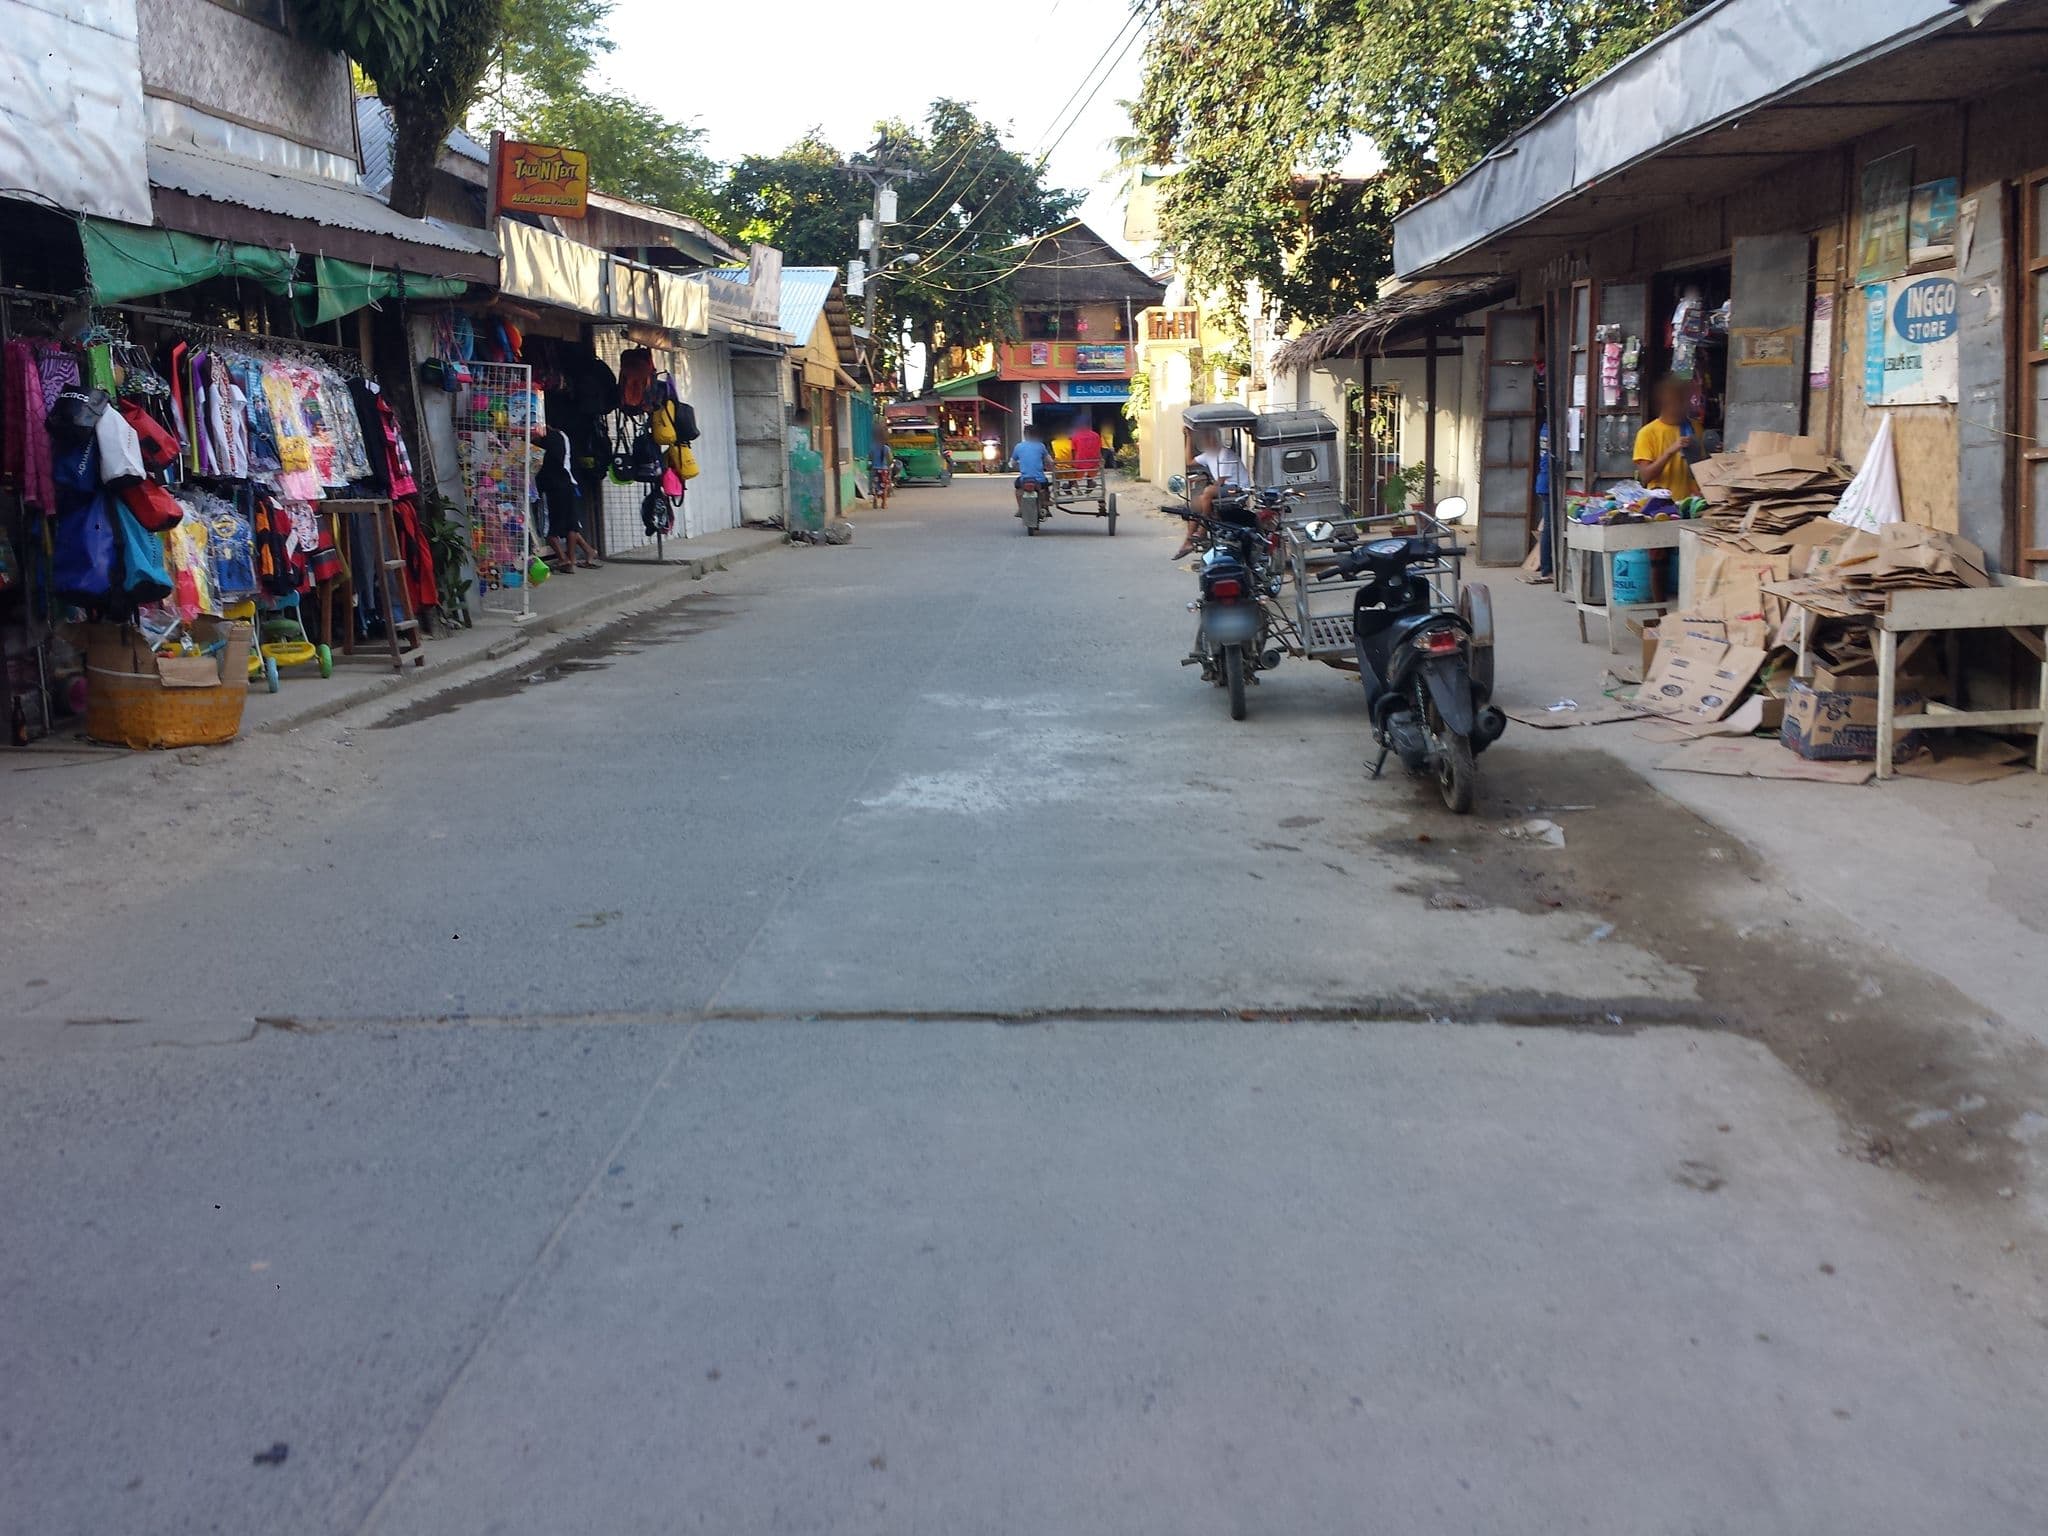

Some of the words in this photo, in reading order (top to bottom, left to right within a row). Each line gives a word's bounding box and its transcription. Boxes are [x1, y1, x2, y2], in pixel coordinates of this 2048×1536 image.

[515, 159, 539, 179] TALK
[554, 161, 578, 180] TEXT
[1906, 284, 1956, 318] INGGO
[1908, 321, 1947, 340] STORE
[1076, 385, 1088, 394] EL
[1090, 385, 1111, 394] NIDO
